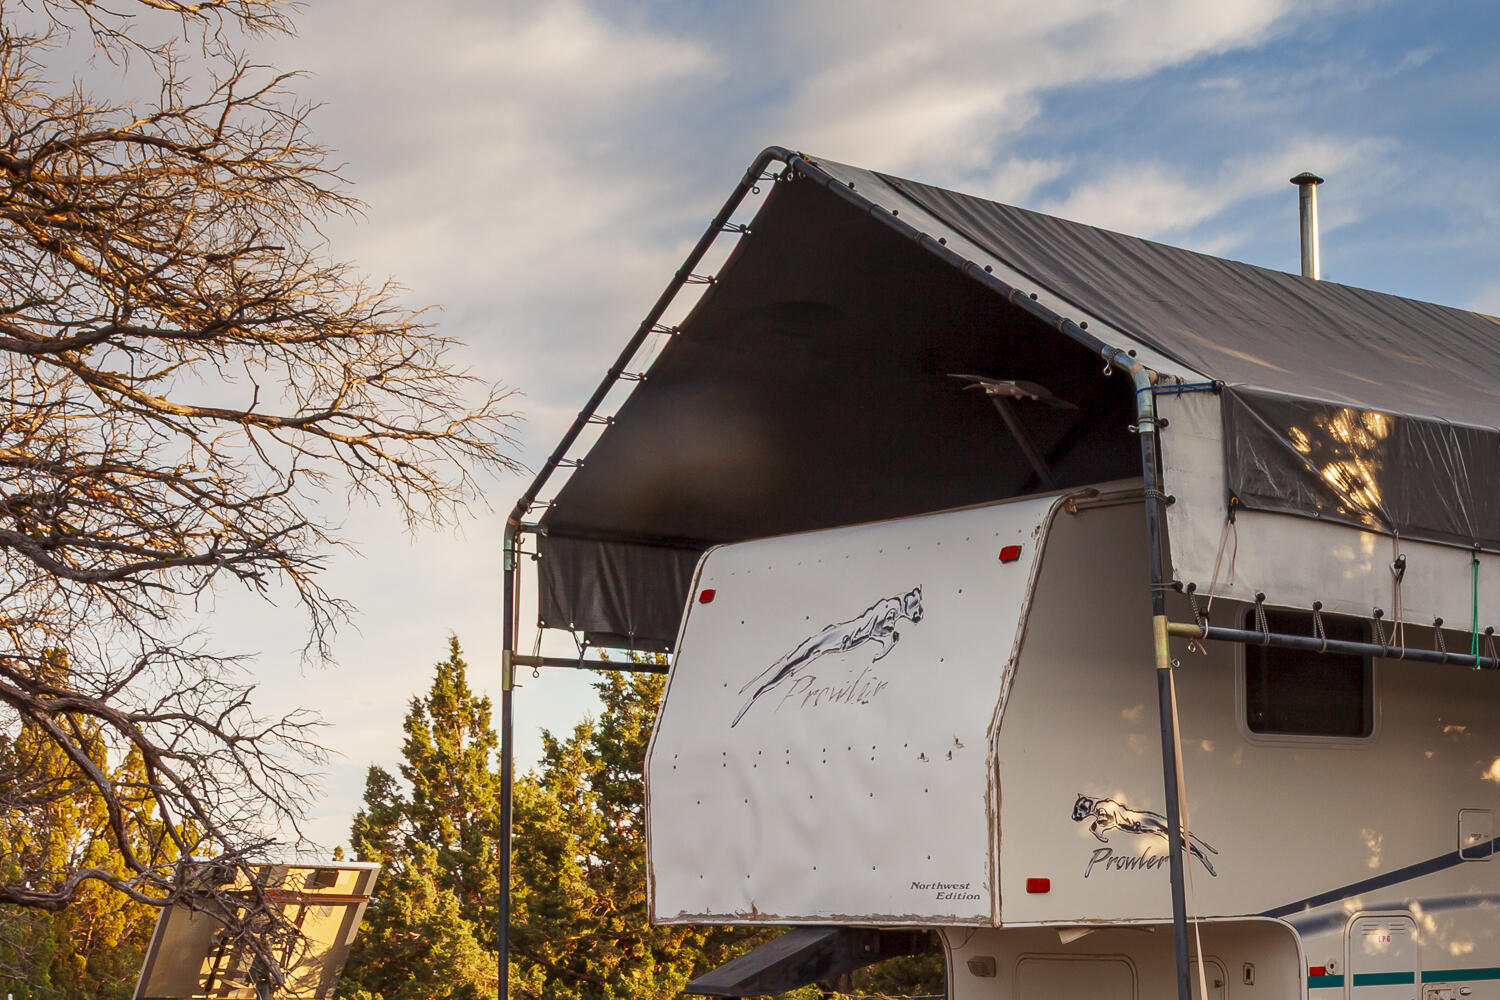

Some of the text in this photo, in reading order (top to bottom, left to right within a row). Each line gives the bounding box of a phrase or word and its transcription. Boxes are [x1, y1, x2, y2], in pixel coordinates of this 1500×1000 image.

[1084, 846, 1170, 878] Prowler
[910, 881, 971, 890] Northwest
[935, 891, 981, 901] Edition
